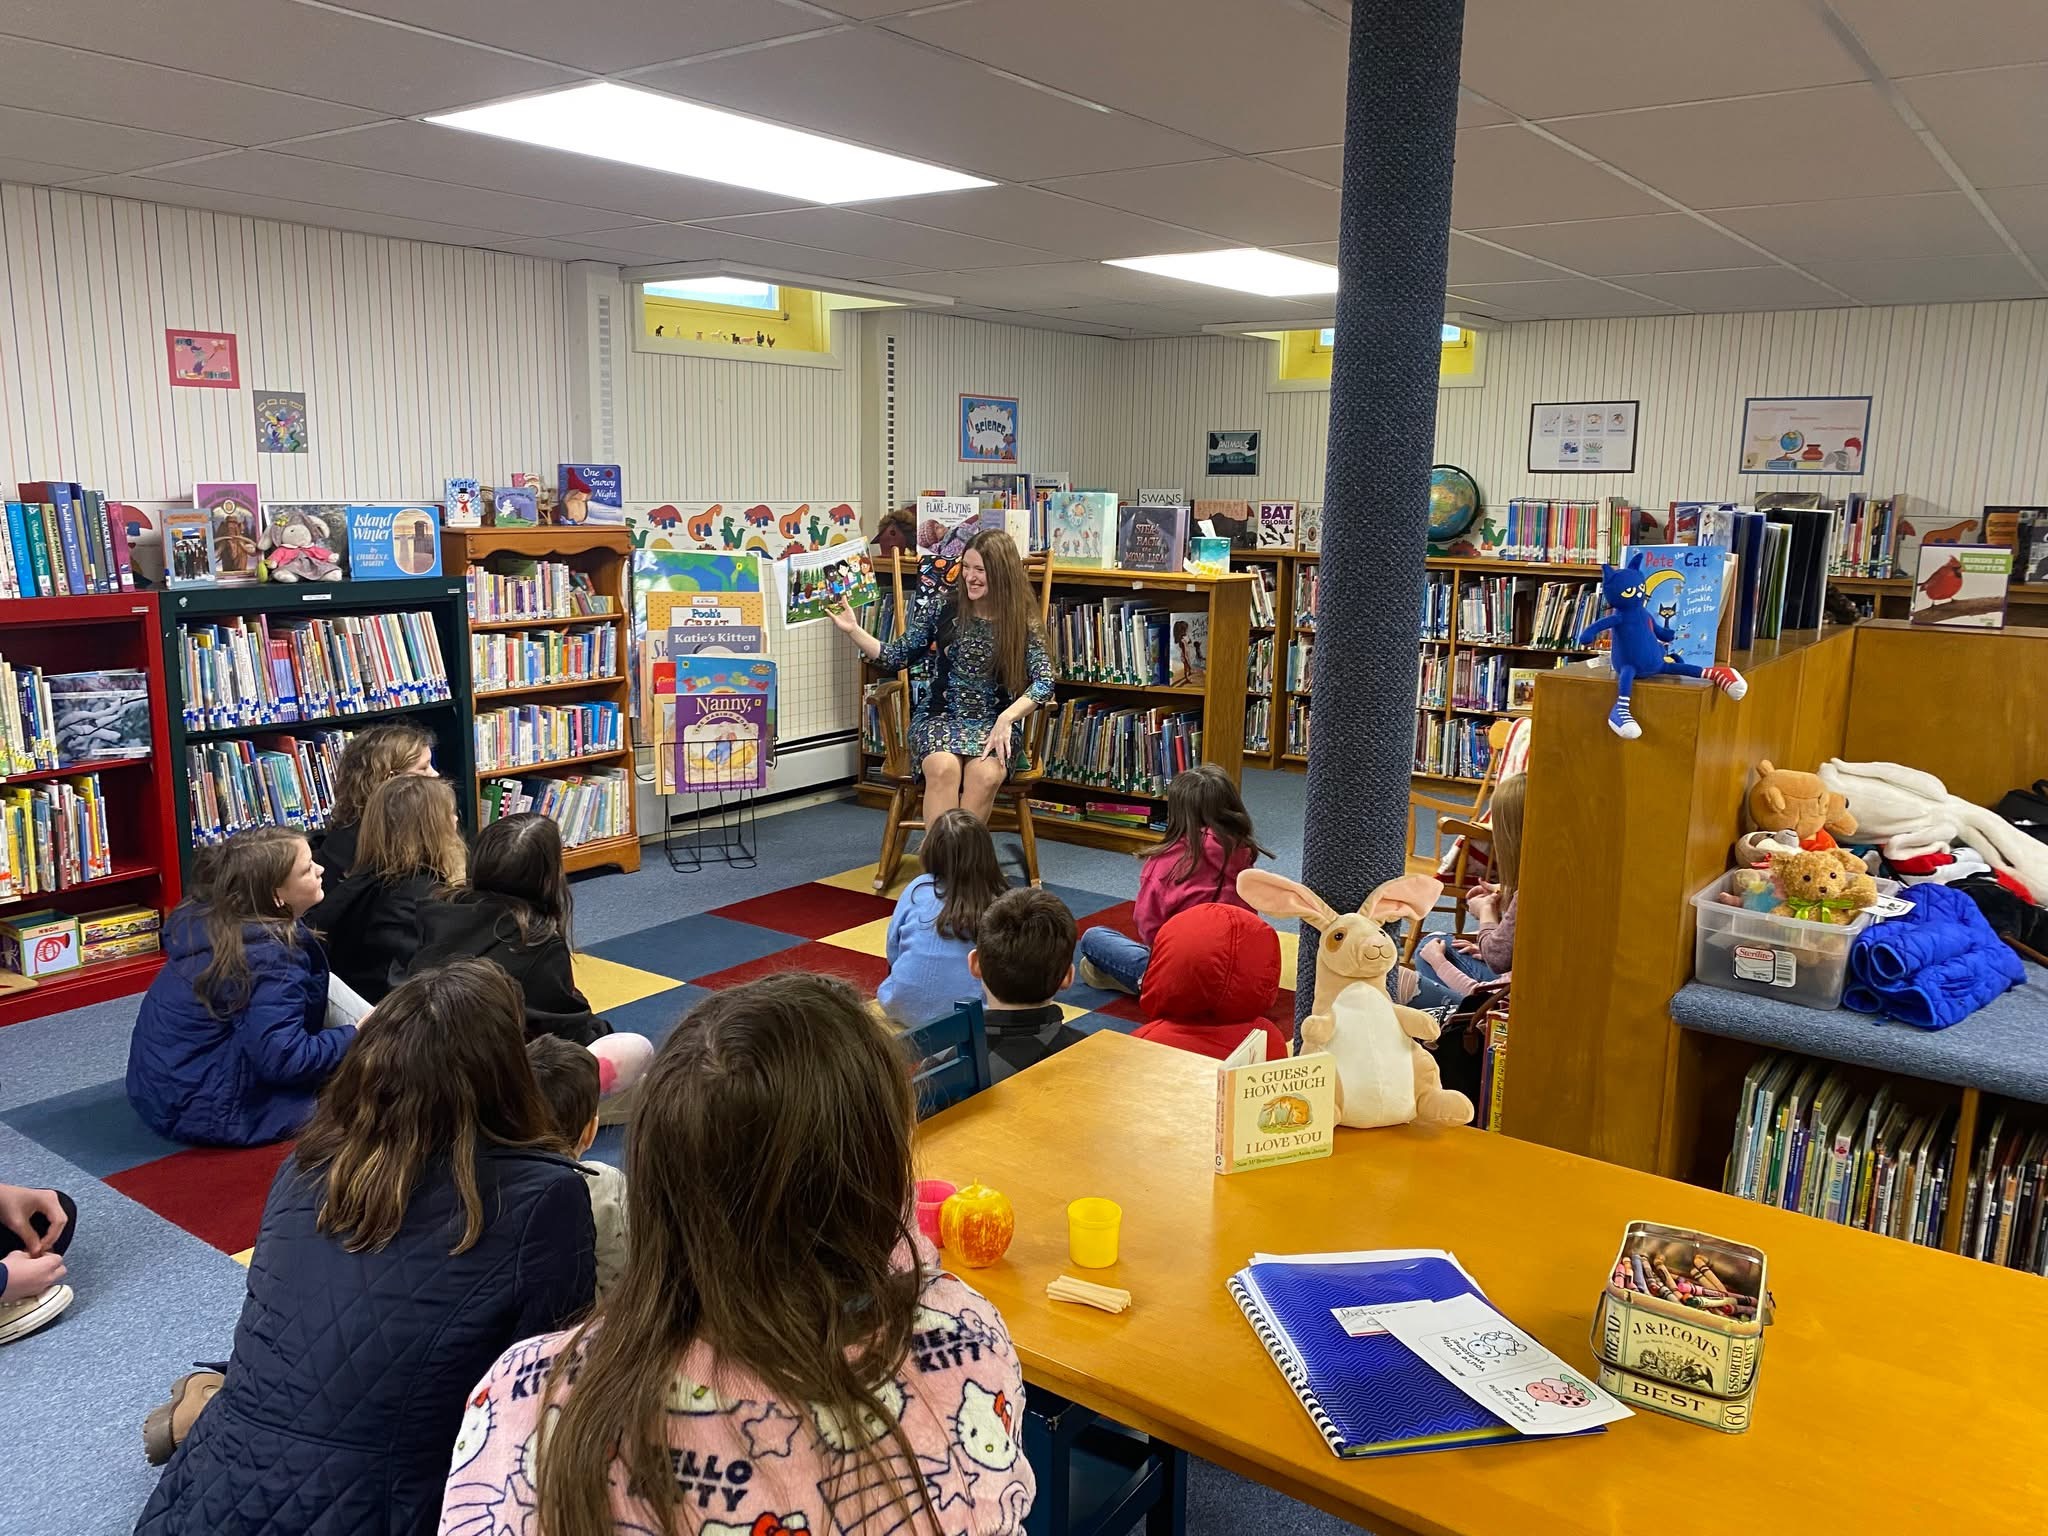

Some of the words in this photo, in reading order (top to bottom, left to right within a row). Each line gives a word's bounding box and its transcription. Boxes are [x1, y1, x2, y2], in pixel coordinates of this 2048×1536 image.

[975, 417, 1006, 435] science
[1219, 440, 1250, 449] ANIMALS
[583, 468, 600, 477] One
[451, 481, 476, 489] Winter
[589, 478, 616, 488] Snowy
[595, 489, 617, 501] Night
[1141, 494, 1181, 504] SWANS
[926, 502, 971, 513] FLAKE-FLYING
[1261, 506, 1293, 520] BAT
[61, 504, 72, 543] Paddington
[98, 500, 111, 549] NUTCRACKER
[354, 513, 393, 529] Island
[352, 527, 392, 542] Winter
[1645, 552, 1674, 568] Pete
[1675, 552, 1685, 560] the
[1684, 552, 1708, 567] Cat
[1687, 584, 1713, 594] Twinkle,
[1686, 595, 1713, 605] Twinkle,
[691, 609, 721, 619] Pooh's
[1683, 606, 1702, 617] Little
[674, 633, 715, 644] Katie's
[718, 633, 756, 642] Kitten
[695, 697, 752, 715] Nanny,
[1740, 948, 1769, 960] Sterilite
[1262, 1066, 1309, 1084] GUESS
[1244, 1083, 1279, 1099] HOW
[1281, 1077, 1326, 1093] MUCH
[1246, 1143, 1251, 1154] I
[1256, 1137, 1290, 1153] LOVE
[1293, 1131, 1322, 1146] YOU
[1633, 1323, 1641, 1335] J
[1645, 1322, 1657, 1334] &
[1728, 1345, 1744, 1396] ASSORTED
[1633, 1382, 1705, 1411] BEST
[1725, 1404, 1746, 1426] 60
